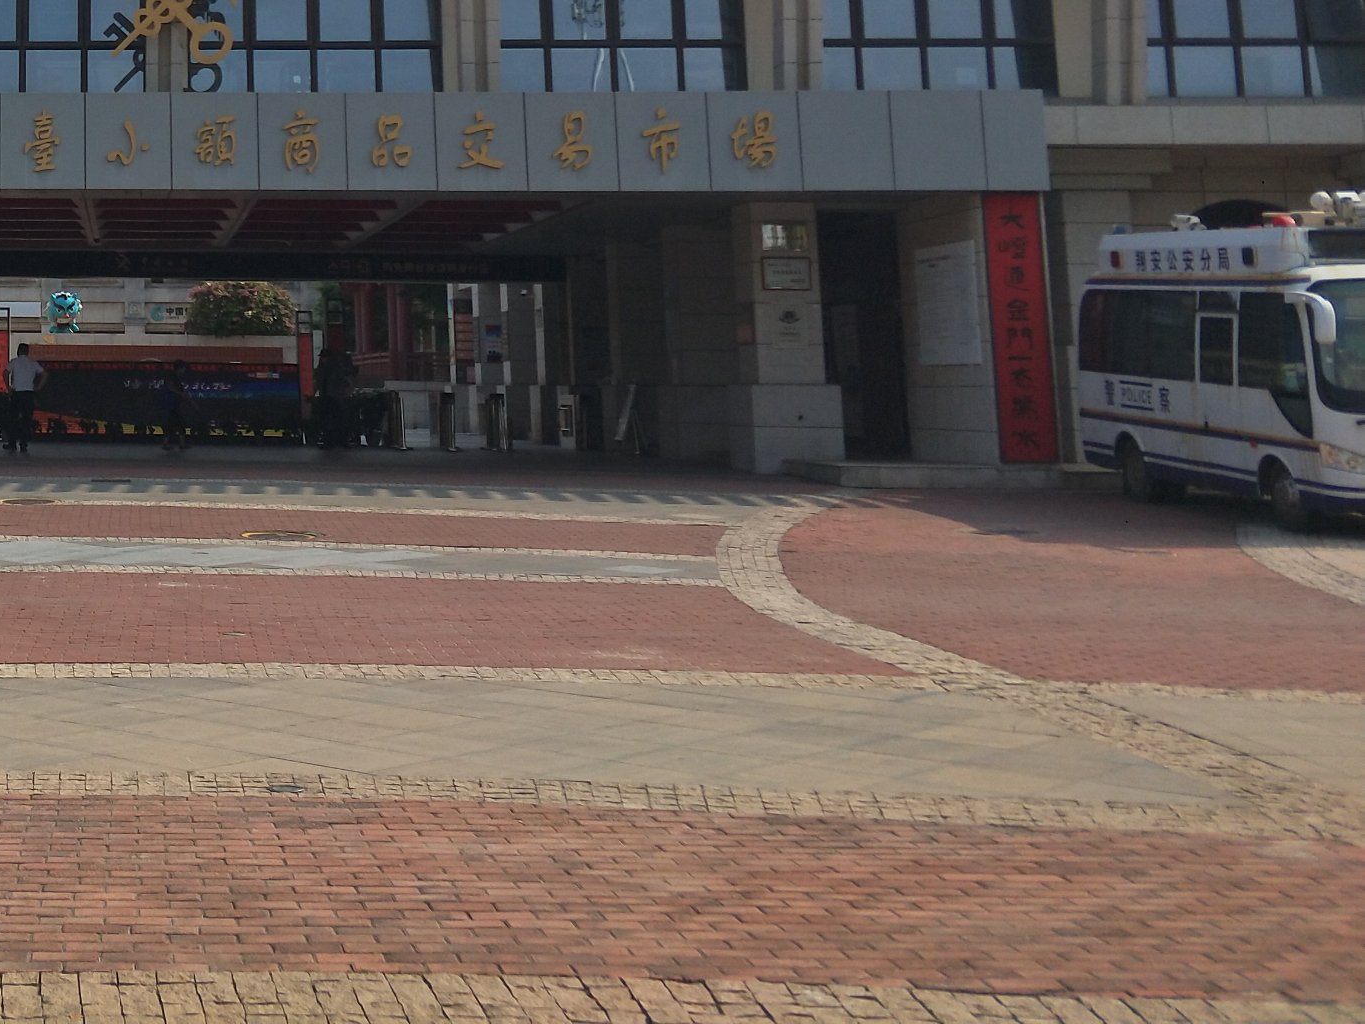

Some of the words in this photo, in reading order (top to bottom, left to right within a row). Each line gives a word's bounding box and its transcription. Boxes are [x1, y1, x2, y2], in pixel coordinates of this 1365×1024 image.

[1135, 248, 1230, 272] 翔安公安分局
[1105, 380, 1115, 406] 警
[1121, 387, 1152, 405] POLICE
[1159, 385, 1171, 413] 察
